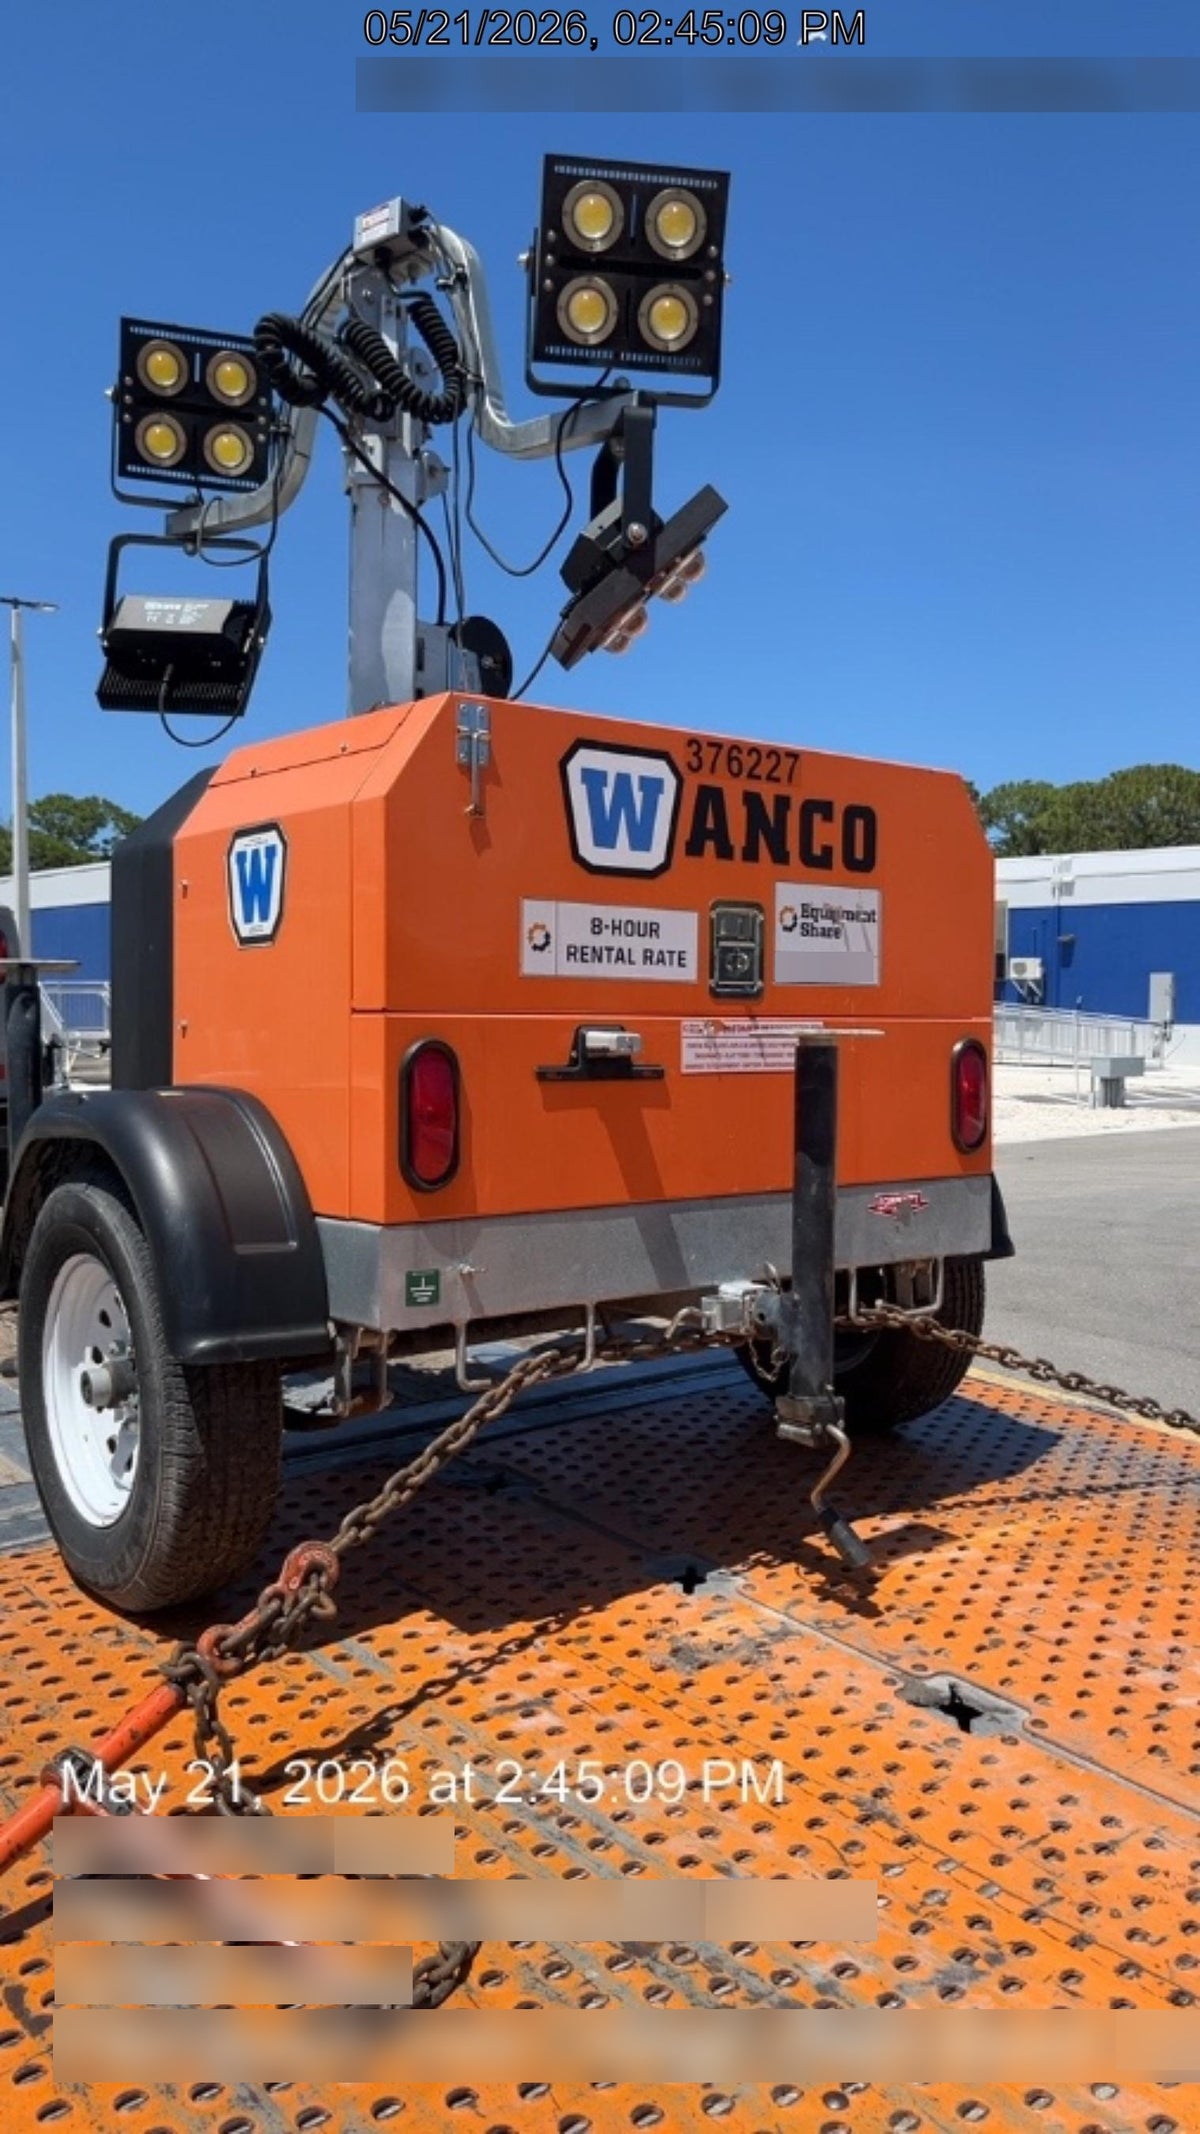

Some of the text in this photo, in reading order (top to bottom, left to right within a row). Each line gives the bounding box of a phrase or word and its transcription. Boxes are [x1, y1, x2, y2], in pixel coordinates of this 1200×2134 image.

[686, 738, 801, 784] 376227
[580, 767, 877, 874] WANCO
[236, 843, 277, 925] W
[800, 903, 877, 924] Equipment
[590, 916, 661, 940] 8-HOUR
[800, 921, 842, 940] Share
[566, 943, 687, 968] RENTAL RATE
